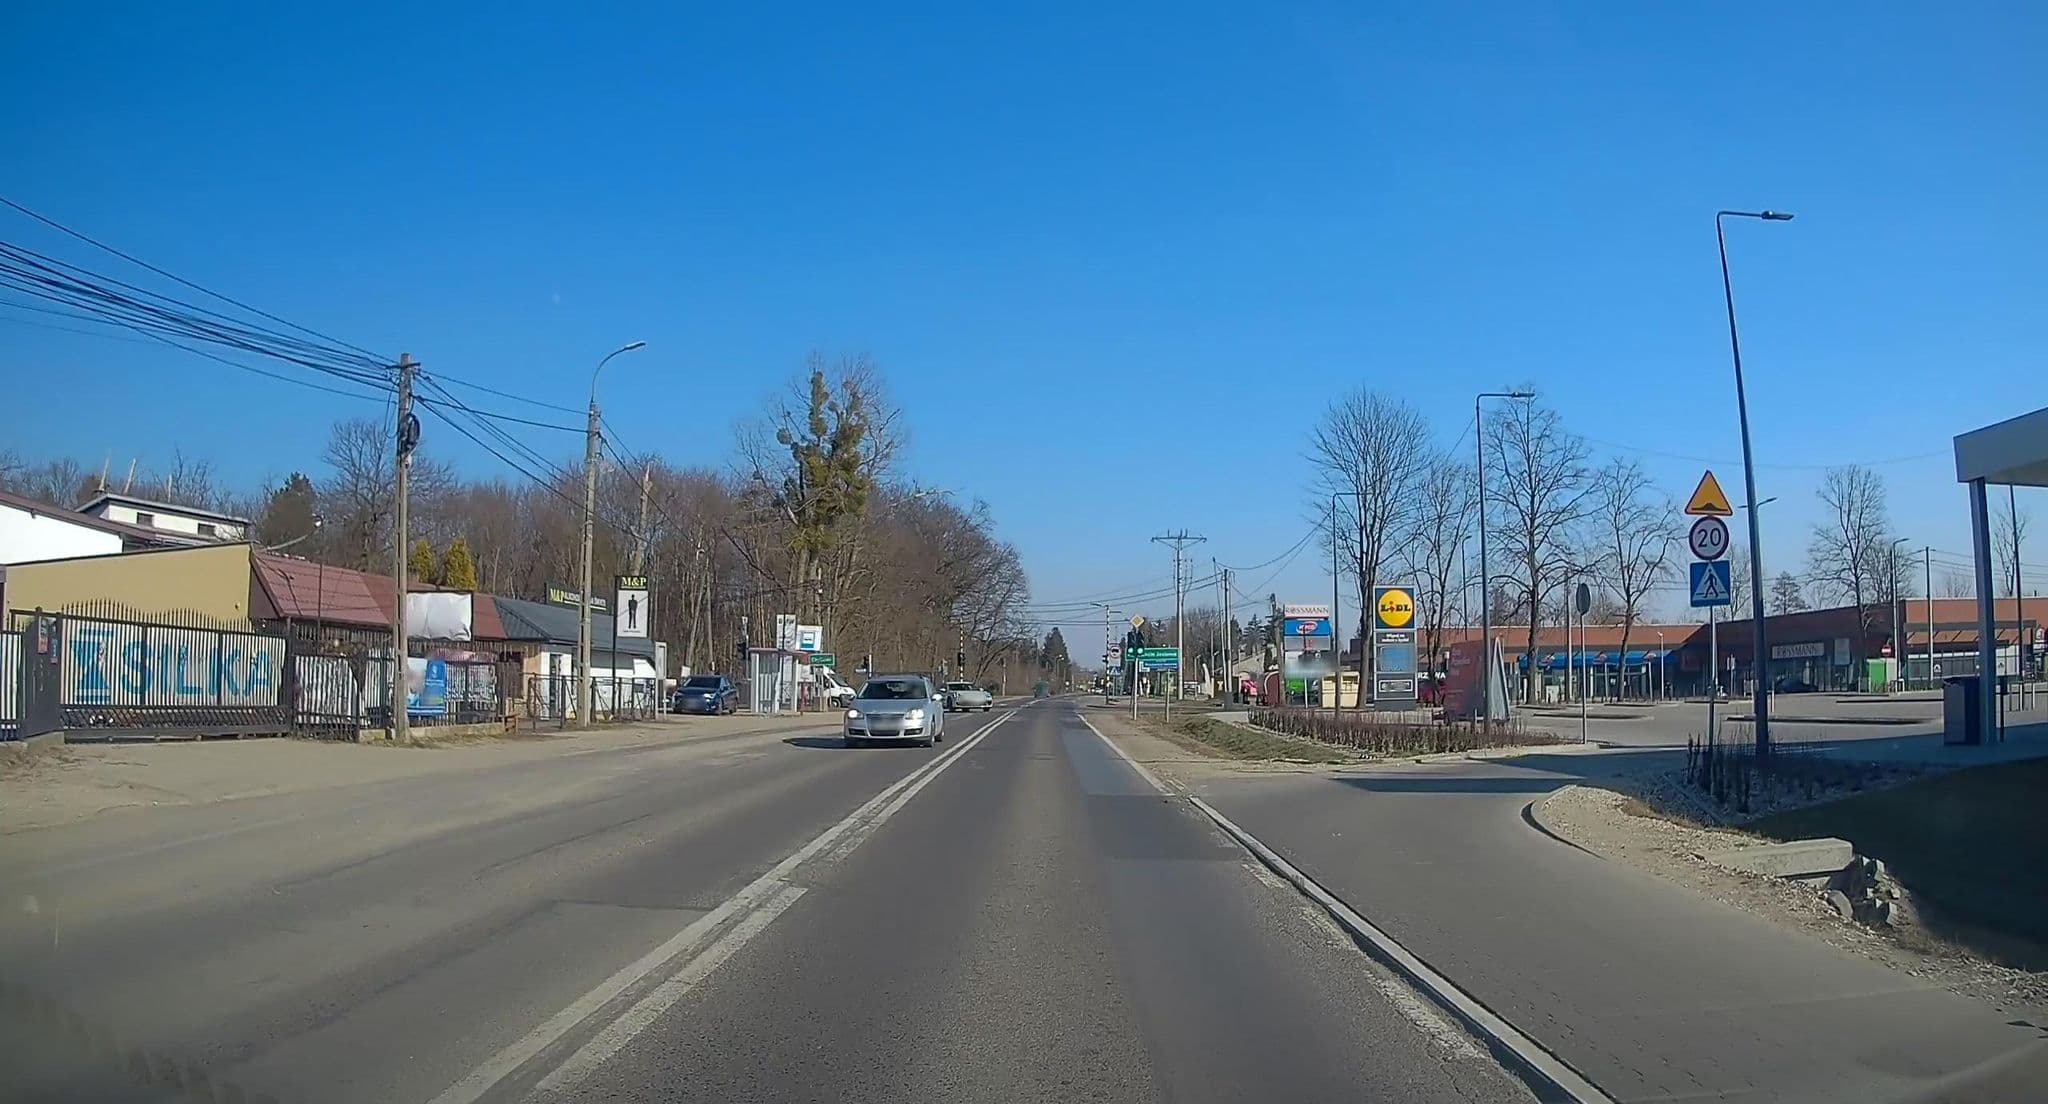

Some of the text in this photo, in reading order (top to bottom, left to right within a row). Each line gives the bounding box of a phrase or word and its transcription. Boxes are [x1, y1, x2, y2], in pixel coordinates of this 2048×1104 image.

[1697, 528, 1722, 547] 20
[621, 577, 647, 586] M&P
[1285, 606, 1329, 614] ROSSMANN
